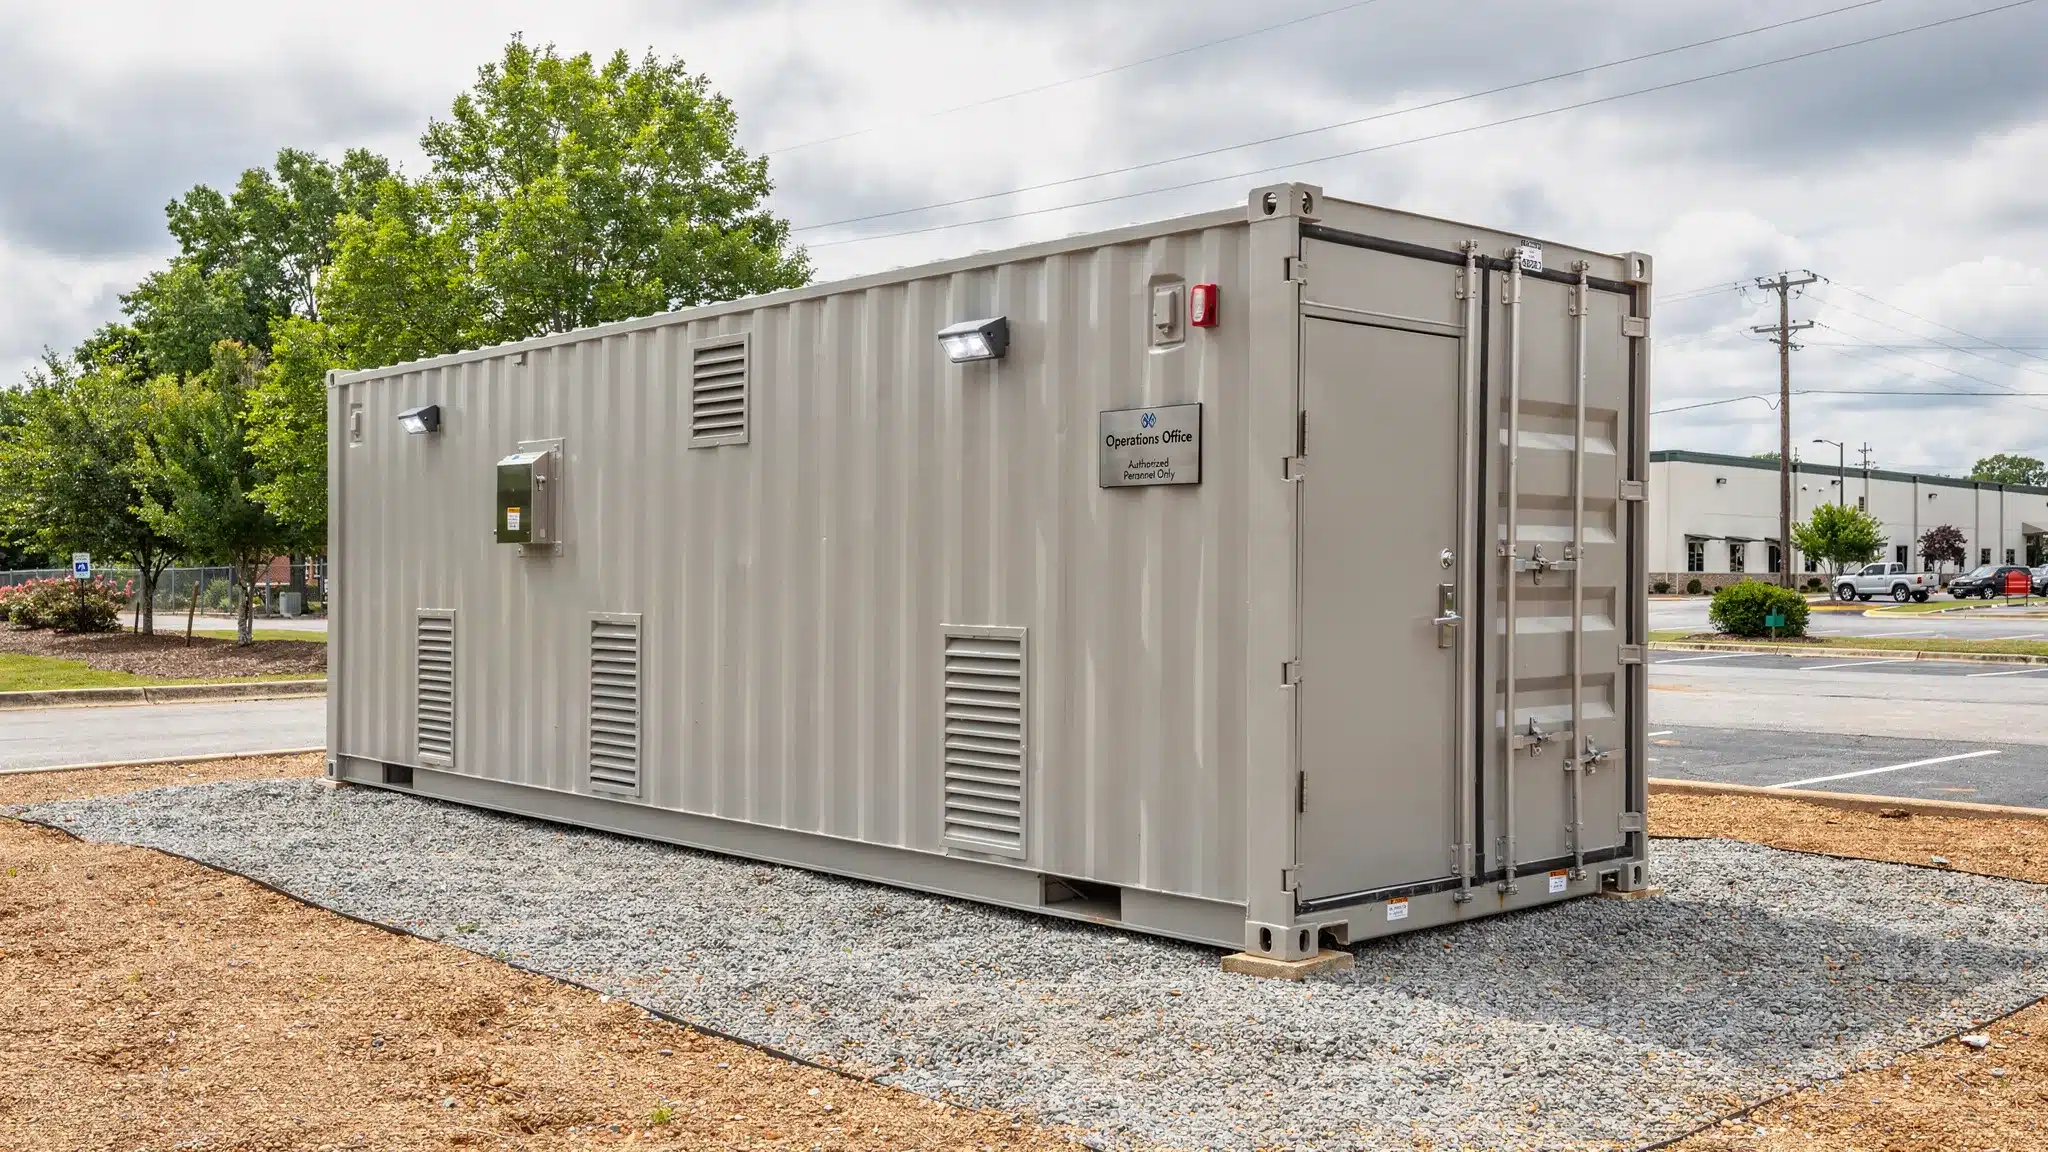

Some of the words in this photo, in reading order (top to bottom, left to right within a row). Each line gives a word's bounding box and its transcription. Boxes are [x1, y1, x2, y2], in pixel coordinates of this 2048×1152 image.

[1106, 433, 1159, 449] Operations
[1162, 429, 1192, 443] Office
[1128, 457, 1169, 468] Authorized
[1157, 468, 1175, 481] Only
